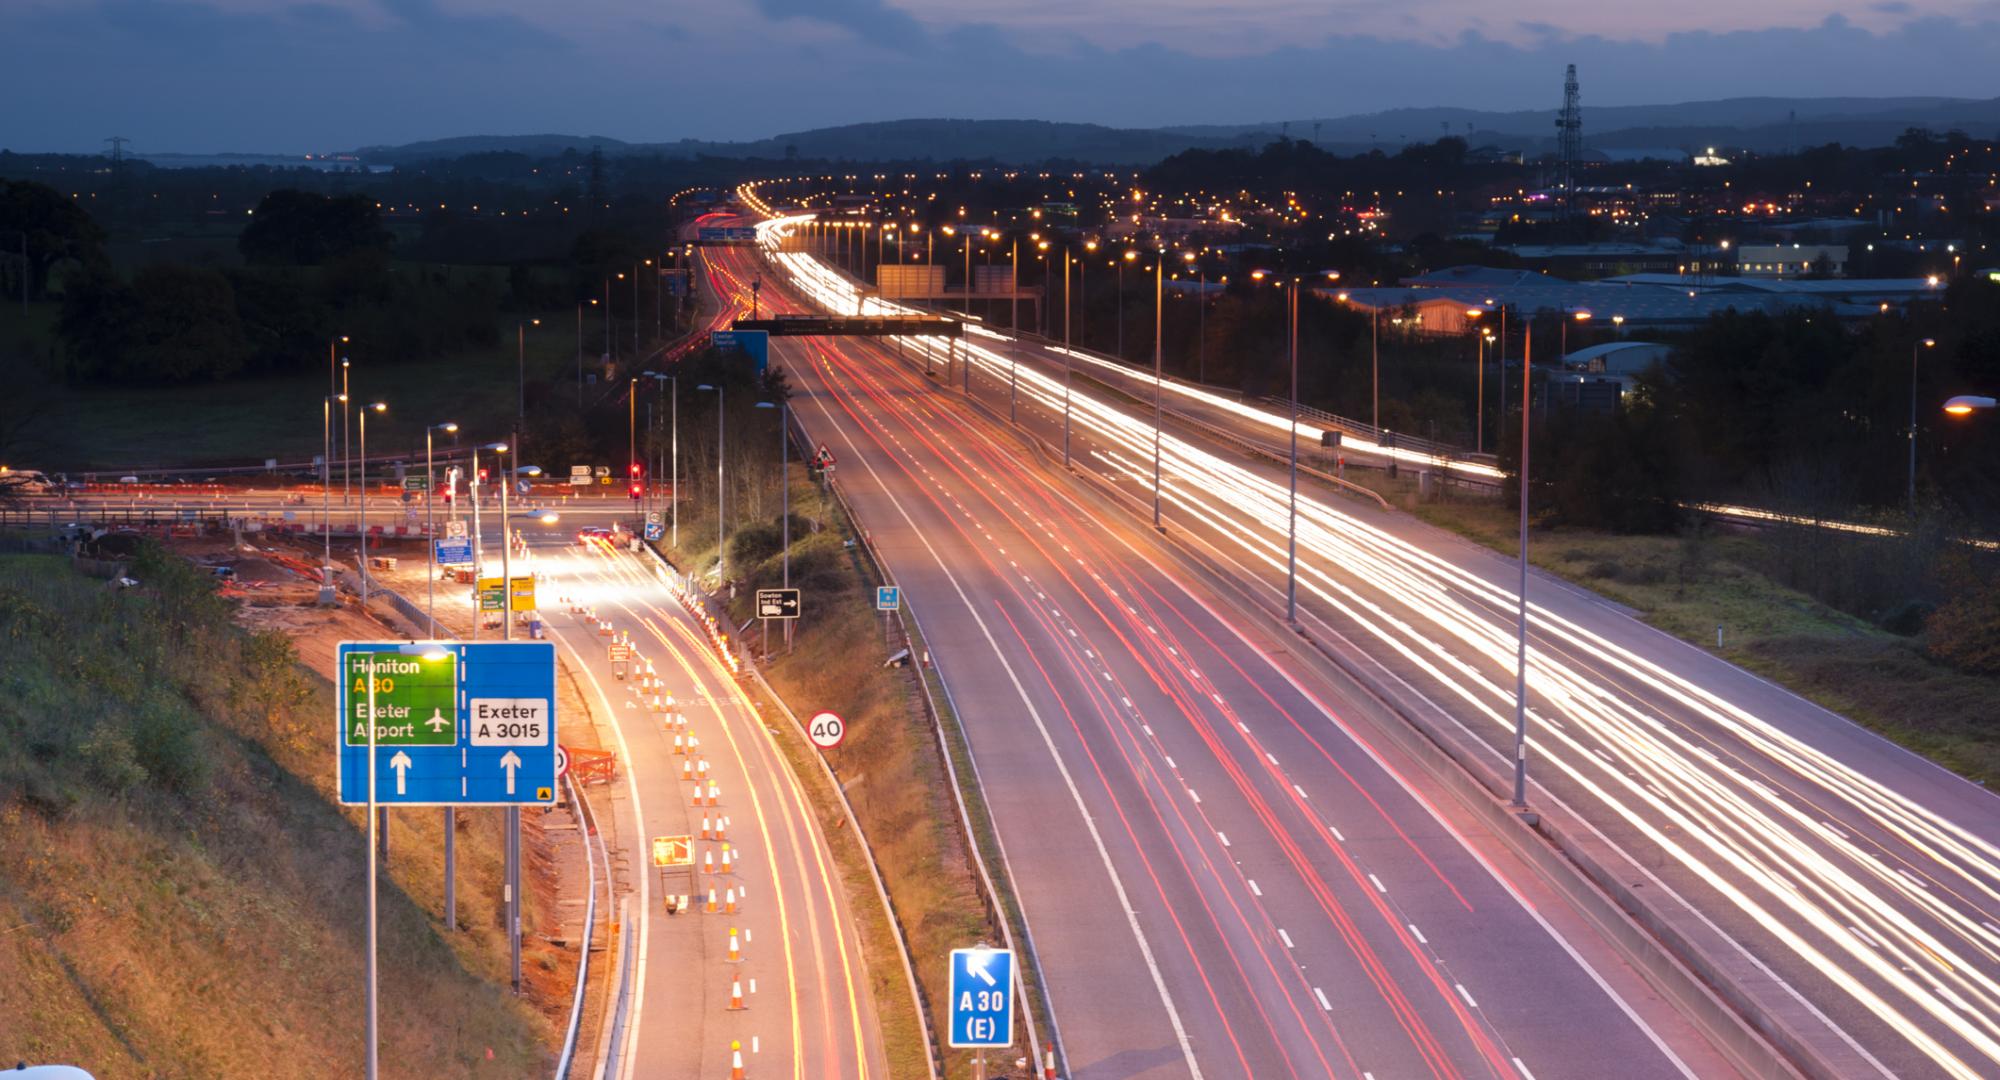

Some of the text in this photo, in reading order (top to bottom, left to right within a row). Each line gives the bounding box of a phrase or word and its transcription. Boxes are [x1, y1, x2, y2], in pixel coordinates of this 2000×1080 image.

[352, 658, 420, 674] Honiton
[356, 702, 411, 718] Eeter
[478, 704, 538, 719] Exeter
[353, 722, 415, 740] Aiport
[478, 723, 540, 738] A 3015
[813, 720, 841, 738] 40
[966, 1016, 996, 1041] (E)
